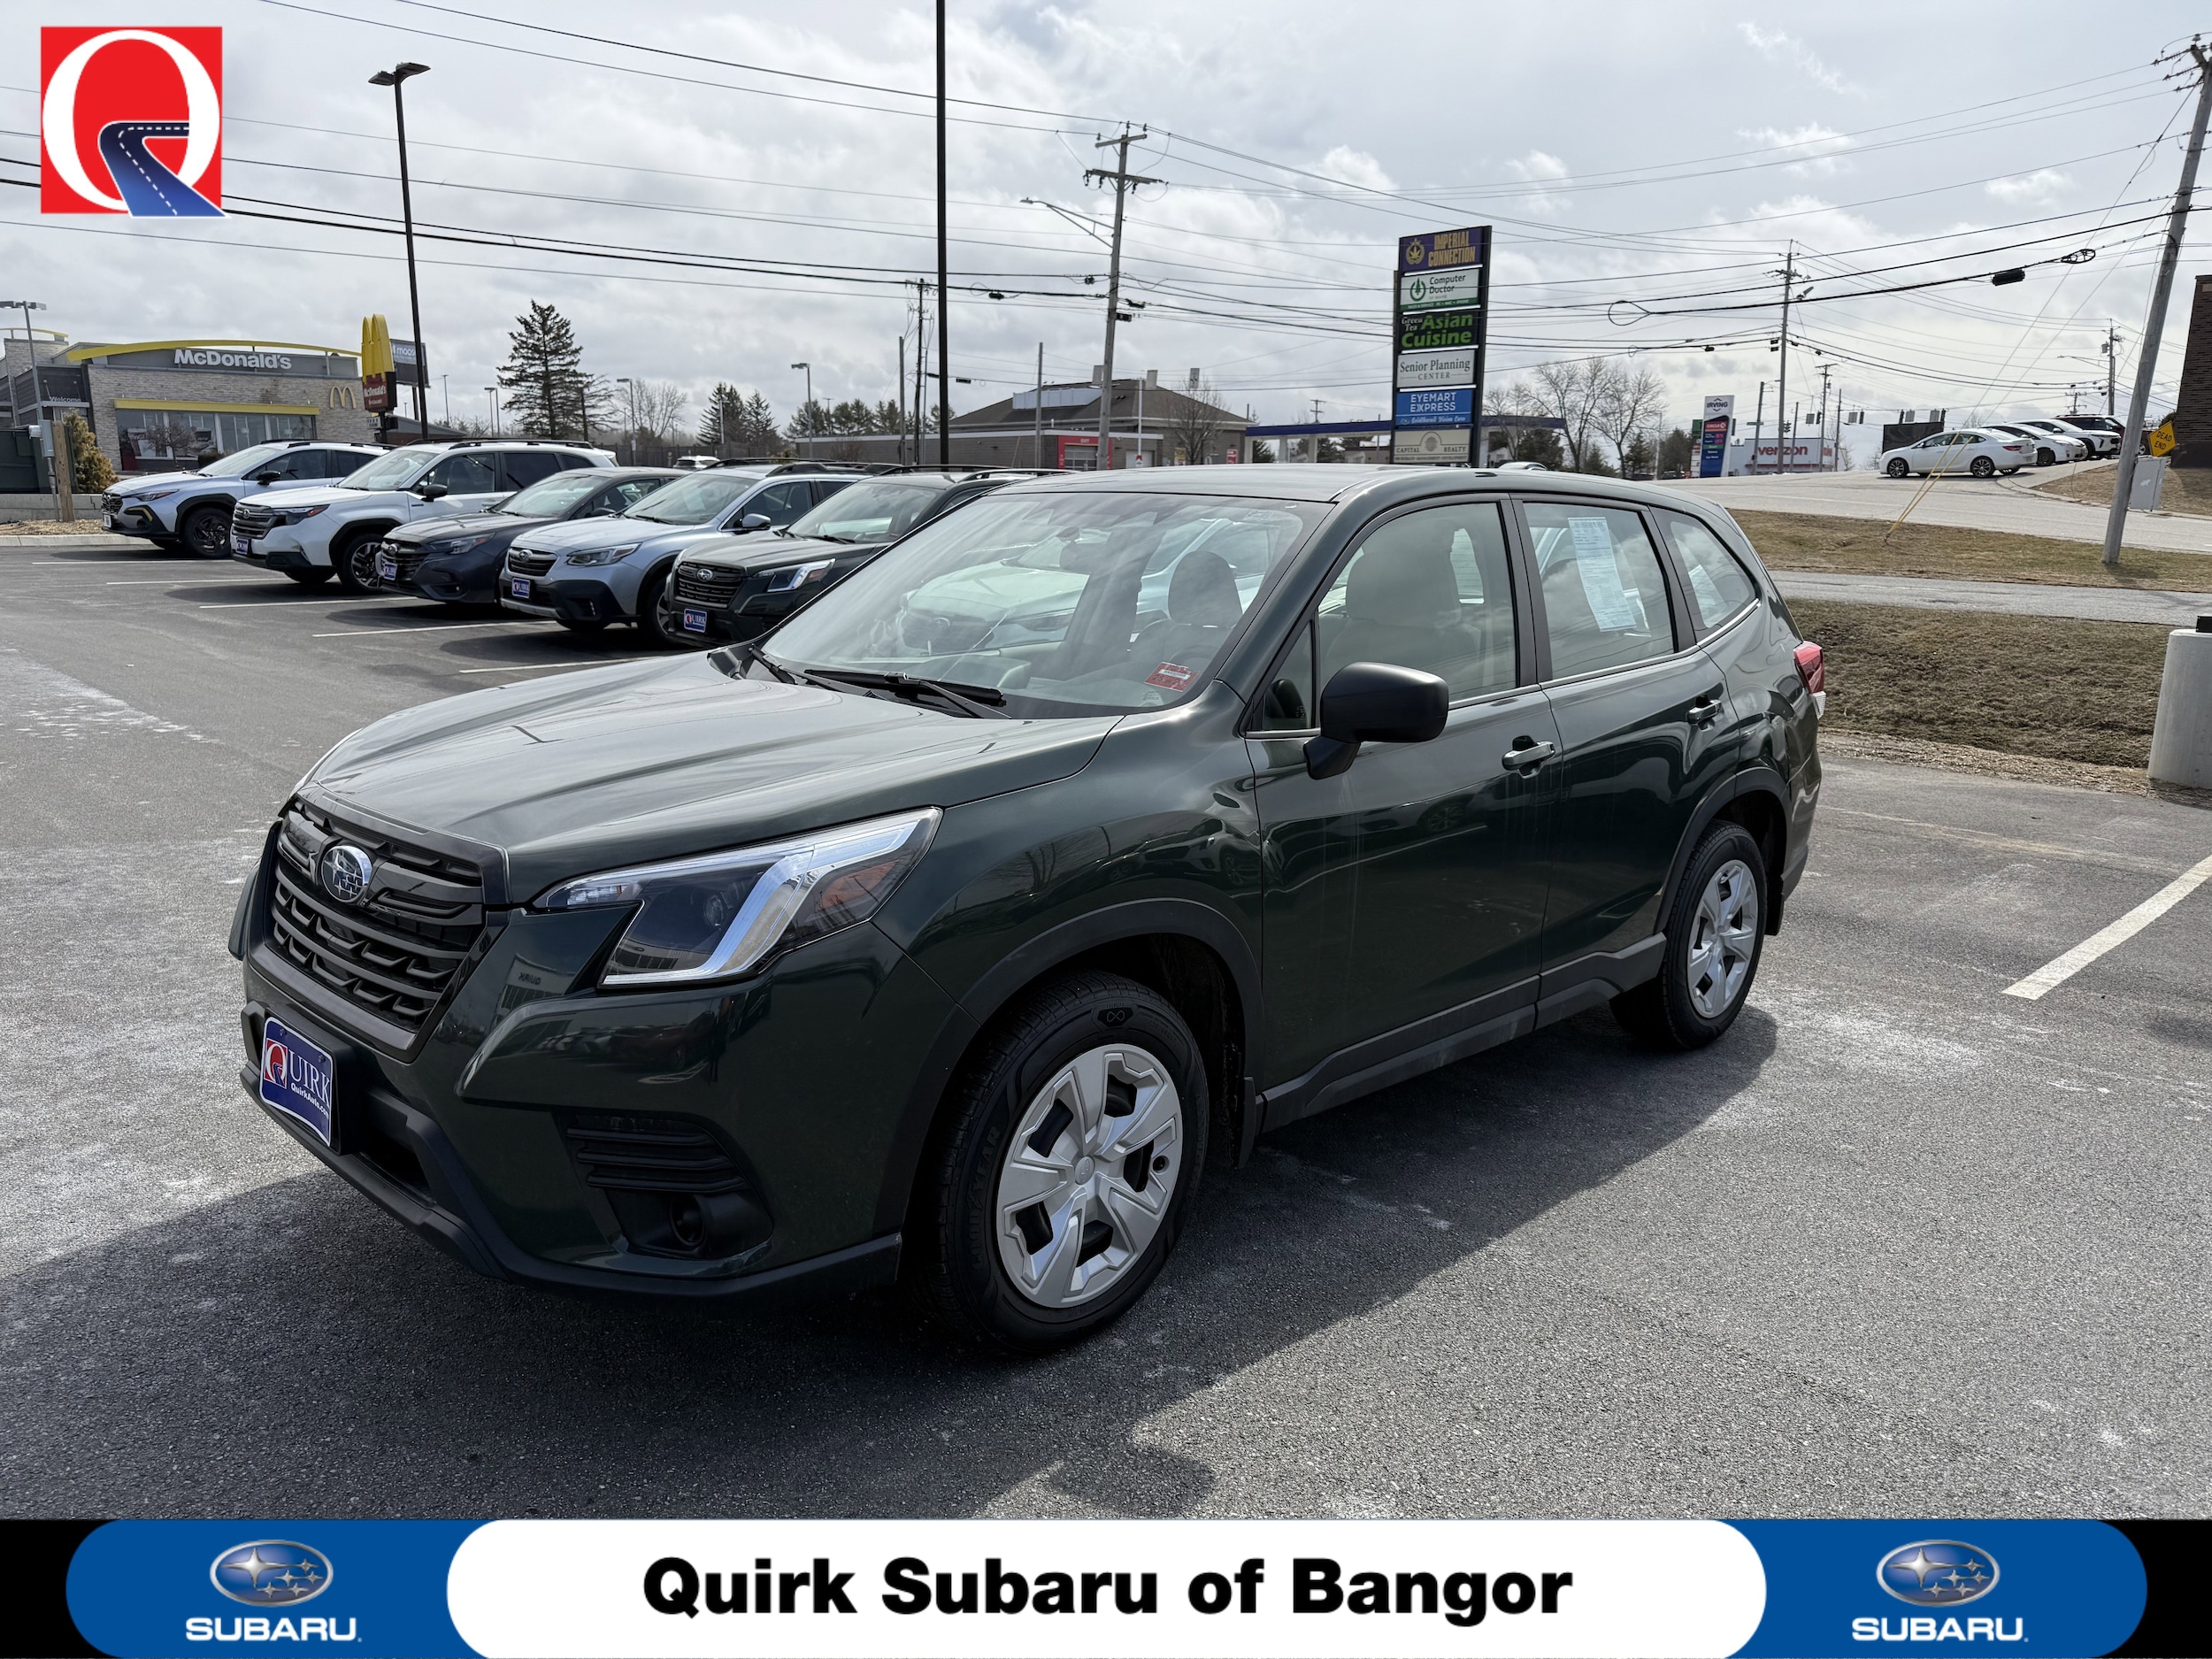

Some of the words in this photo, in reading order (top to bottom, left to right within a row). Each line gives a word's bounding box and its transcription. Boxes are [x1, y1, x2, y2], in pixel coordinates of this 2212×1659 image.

[1433, 231, 1469, 250] IMPERIAL
[1428, 246, 1476, 267] CONNECTION
[1429, 274, 1466, 285] Computer
[1429, 284, 1455, 294] Doctor
[1421, 313, 1473, 331] Asian
[1402, 330, 1472, 348] Cuisine
[174, 349, 292, 369] McDonald's
[1400, 359, 1428, 373] Senior
[1430, 358, 1471, 372] Planning
[1417, 372, 1451, 380] CENTER
[1410, 392, 1456, 403] EYEMART
[1410, 402, 1456, 412] EXPRESS
[2156, 431, 2172, 442] DEAD
[2154, 441, 2166, 449] END
[1758, 446, 1809, 456] verzon
[290, 1082, 329, 1120] QuirkAuto.com
